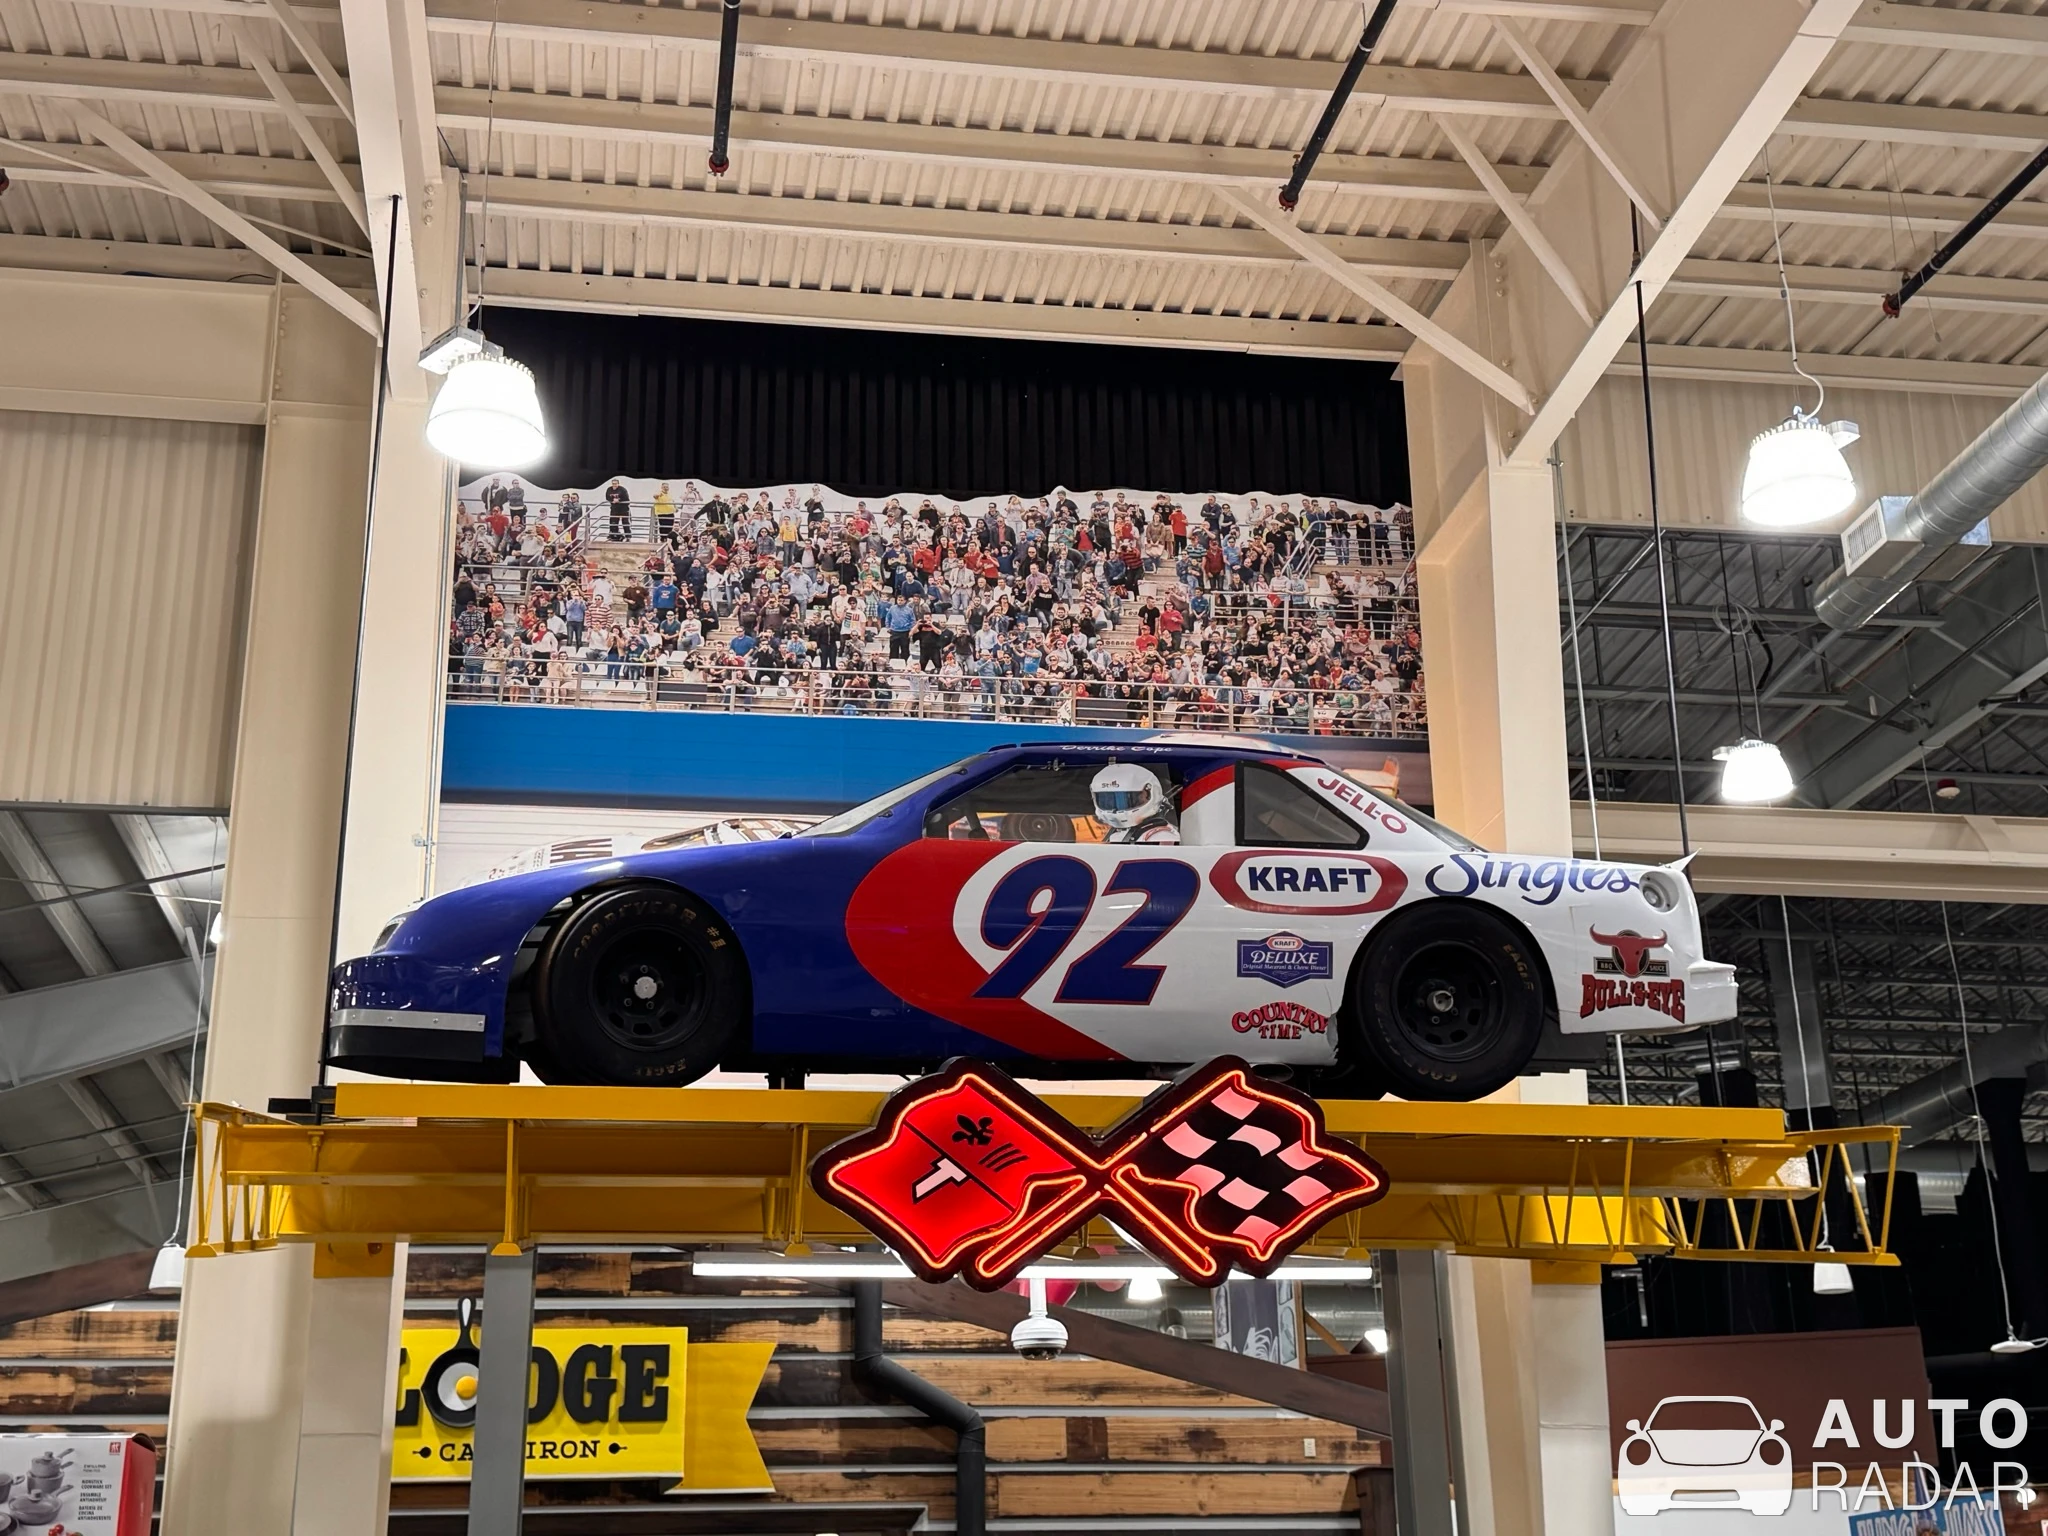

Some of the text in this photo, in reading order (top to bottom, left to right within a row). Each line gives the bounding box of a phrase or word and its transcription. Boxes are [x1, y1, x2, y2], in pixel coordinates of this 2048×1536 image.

[1131, 745, 1173, 754] Cope
[1317, 778, 1407, 833] JELL-O
[1247, 866, 1372, 893] KRAFT
[1425, 853, 1640, 906] Singles
[971, 854, 1200, 1005] 92
[1250, 950, 1319, 965] DELUXE
[1231, 1002, 1329, 1034] COUNTRY
[1258, 1024, 1302, 1040] TIME
[526, 1440, 600, 1459] IRON
